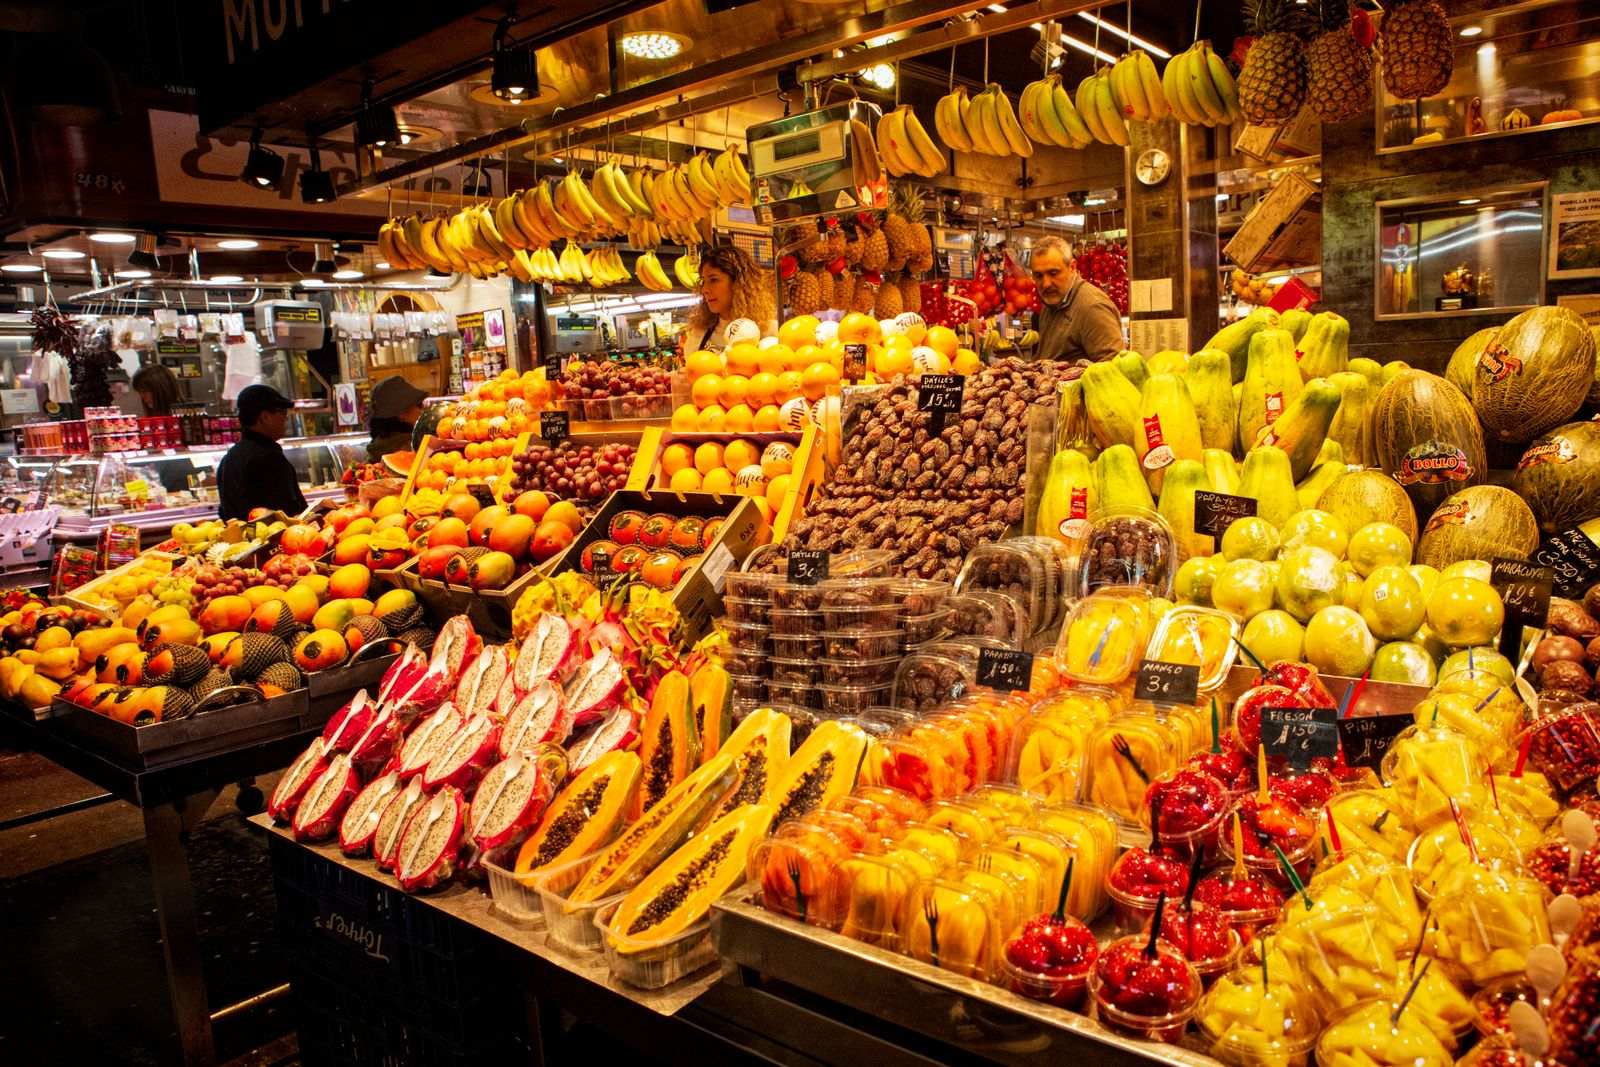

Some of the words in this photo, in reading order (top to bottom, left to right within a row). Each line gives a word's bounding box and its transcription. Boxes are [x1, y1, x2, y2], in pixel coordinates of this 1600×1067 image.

[1413, 457, 1458, 470] BOLLO
[1143, 663, 1183, 674] MANGO
[1269, 708, 1316, 721] FRESON
